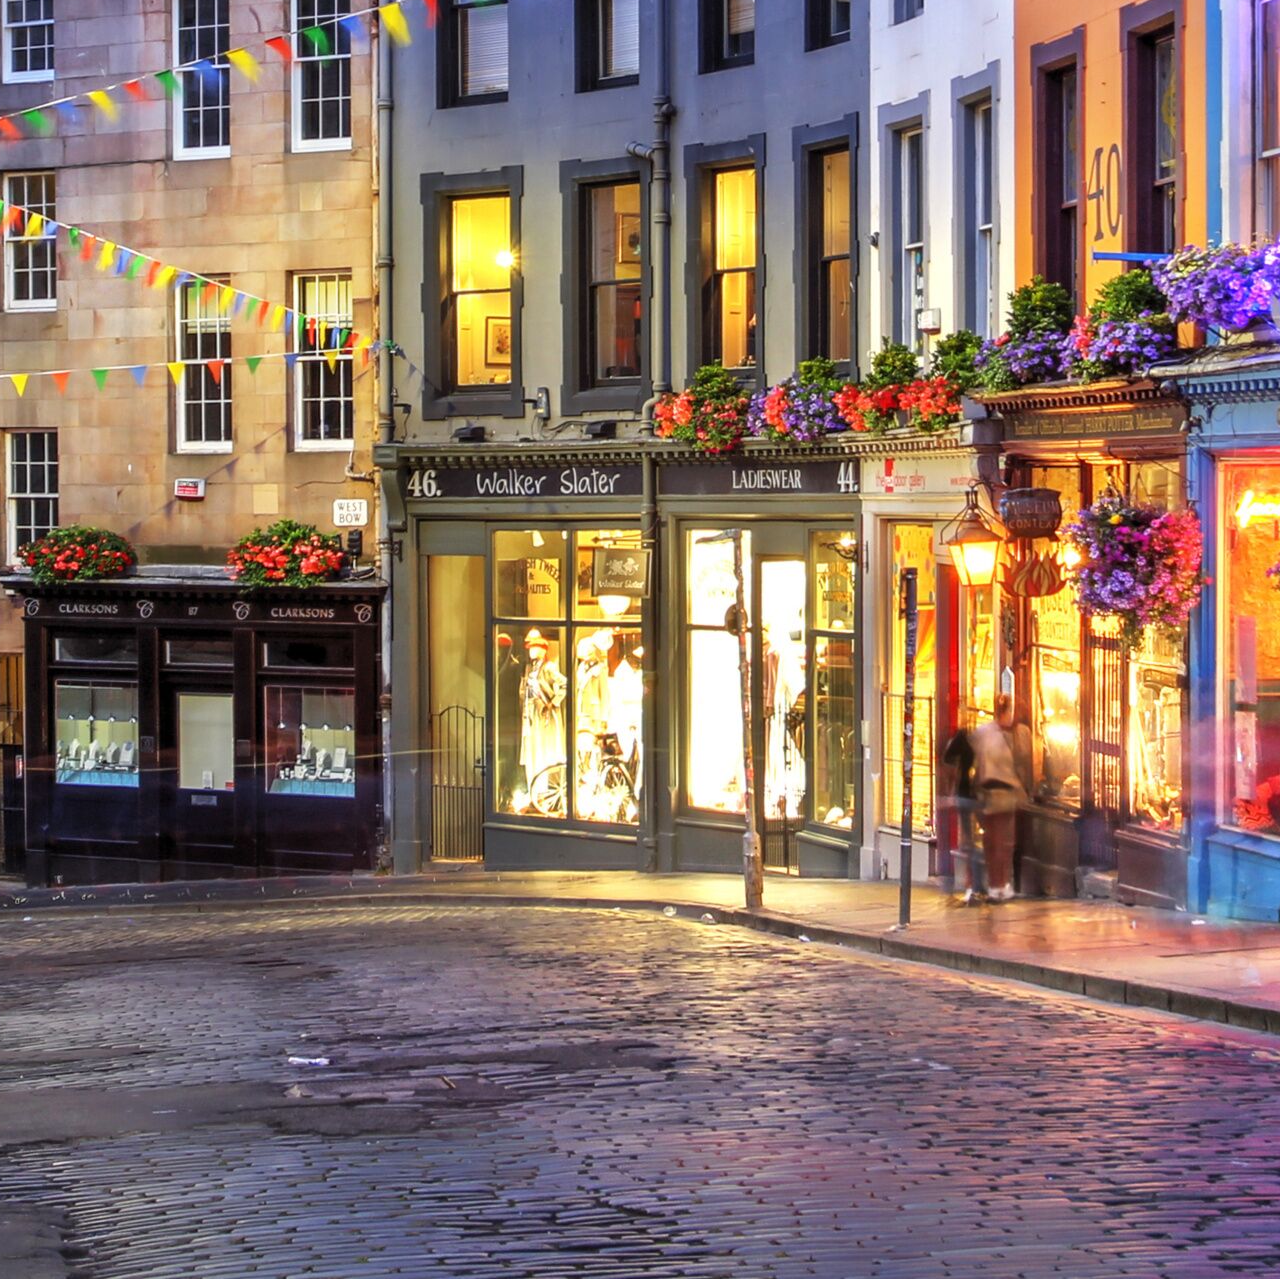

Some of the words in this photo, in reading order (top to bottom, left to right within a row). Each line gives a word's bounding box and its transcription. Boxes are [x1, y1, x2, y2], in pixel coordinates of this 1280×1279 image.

[1087, 143, 1121, 242] 40
[407, 470, 442, 497] 46.
[476, 468, 547, 496] Walker
[559, 467, 621, 494] Slater
[732, 469, 802, 489] LADIESWEAR
[837, 462, 860, 493] 44.
[337, 502, 362, 512] WEST
[339, 514, 361, 523] BOW
[58, 604, 118, 614] CLARKSONS
[188, 606, 199, 616] 87
[270, 607, 335, 618] CLARKSONS
